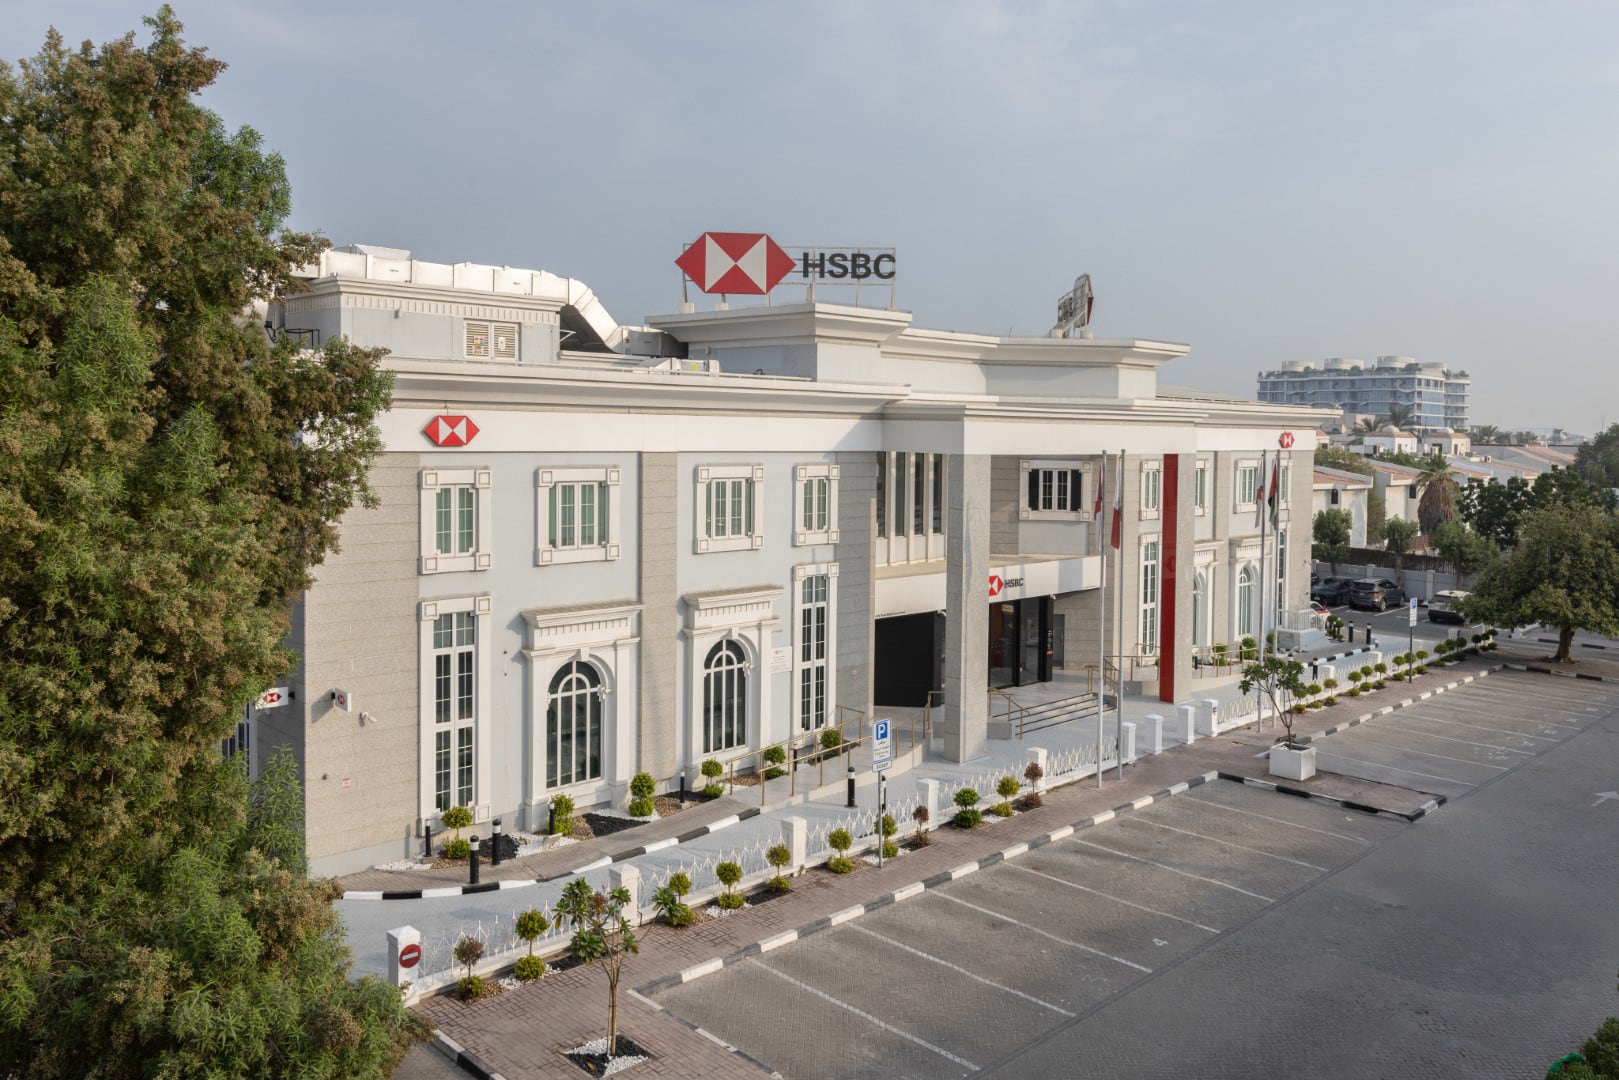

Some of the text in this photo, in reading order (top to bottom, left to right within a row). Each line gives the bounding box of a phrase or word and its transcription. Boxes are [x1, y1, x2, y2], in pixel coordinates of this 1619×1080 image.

[803, 252, 896, 279] HSBC
[1004, 577, 1024, 588] HSBC
[878, 723, 886, 739] P
